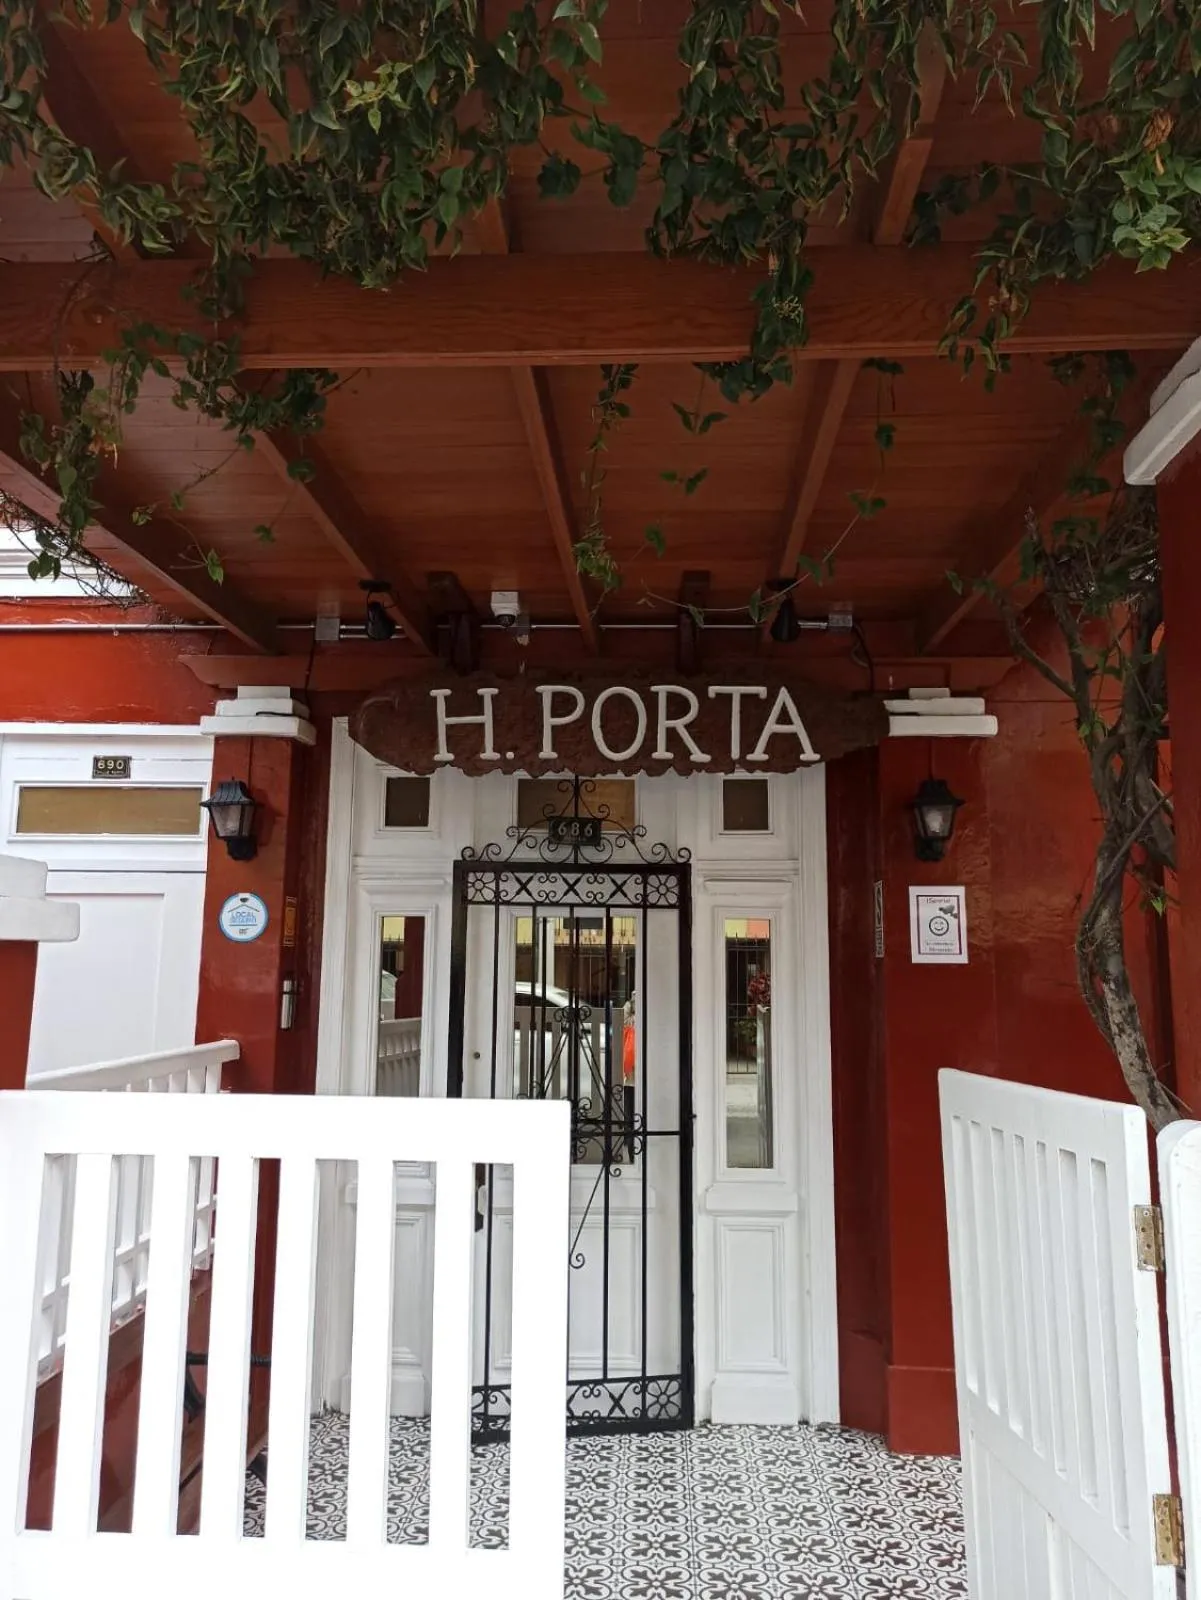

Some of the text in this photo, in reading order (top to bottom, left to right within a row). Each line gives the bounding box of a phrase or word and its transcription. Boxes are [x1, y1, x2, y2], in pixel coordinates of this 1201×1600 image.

[429, 685, 821, 763] H. PORTA
[97, 759, 125, 770] 690
[558, 822, 593, 837] 686
